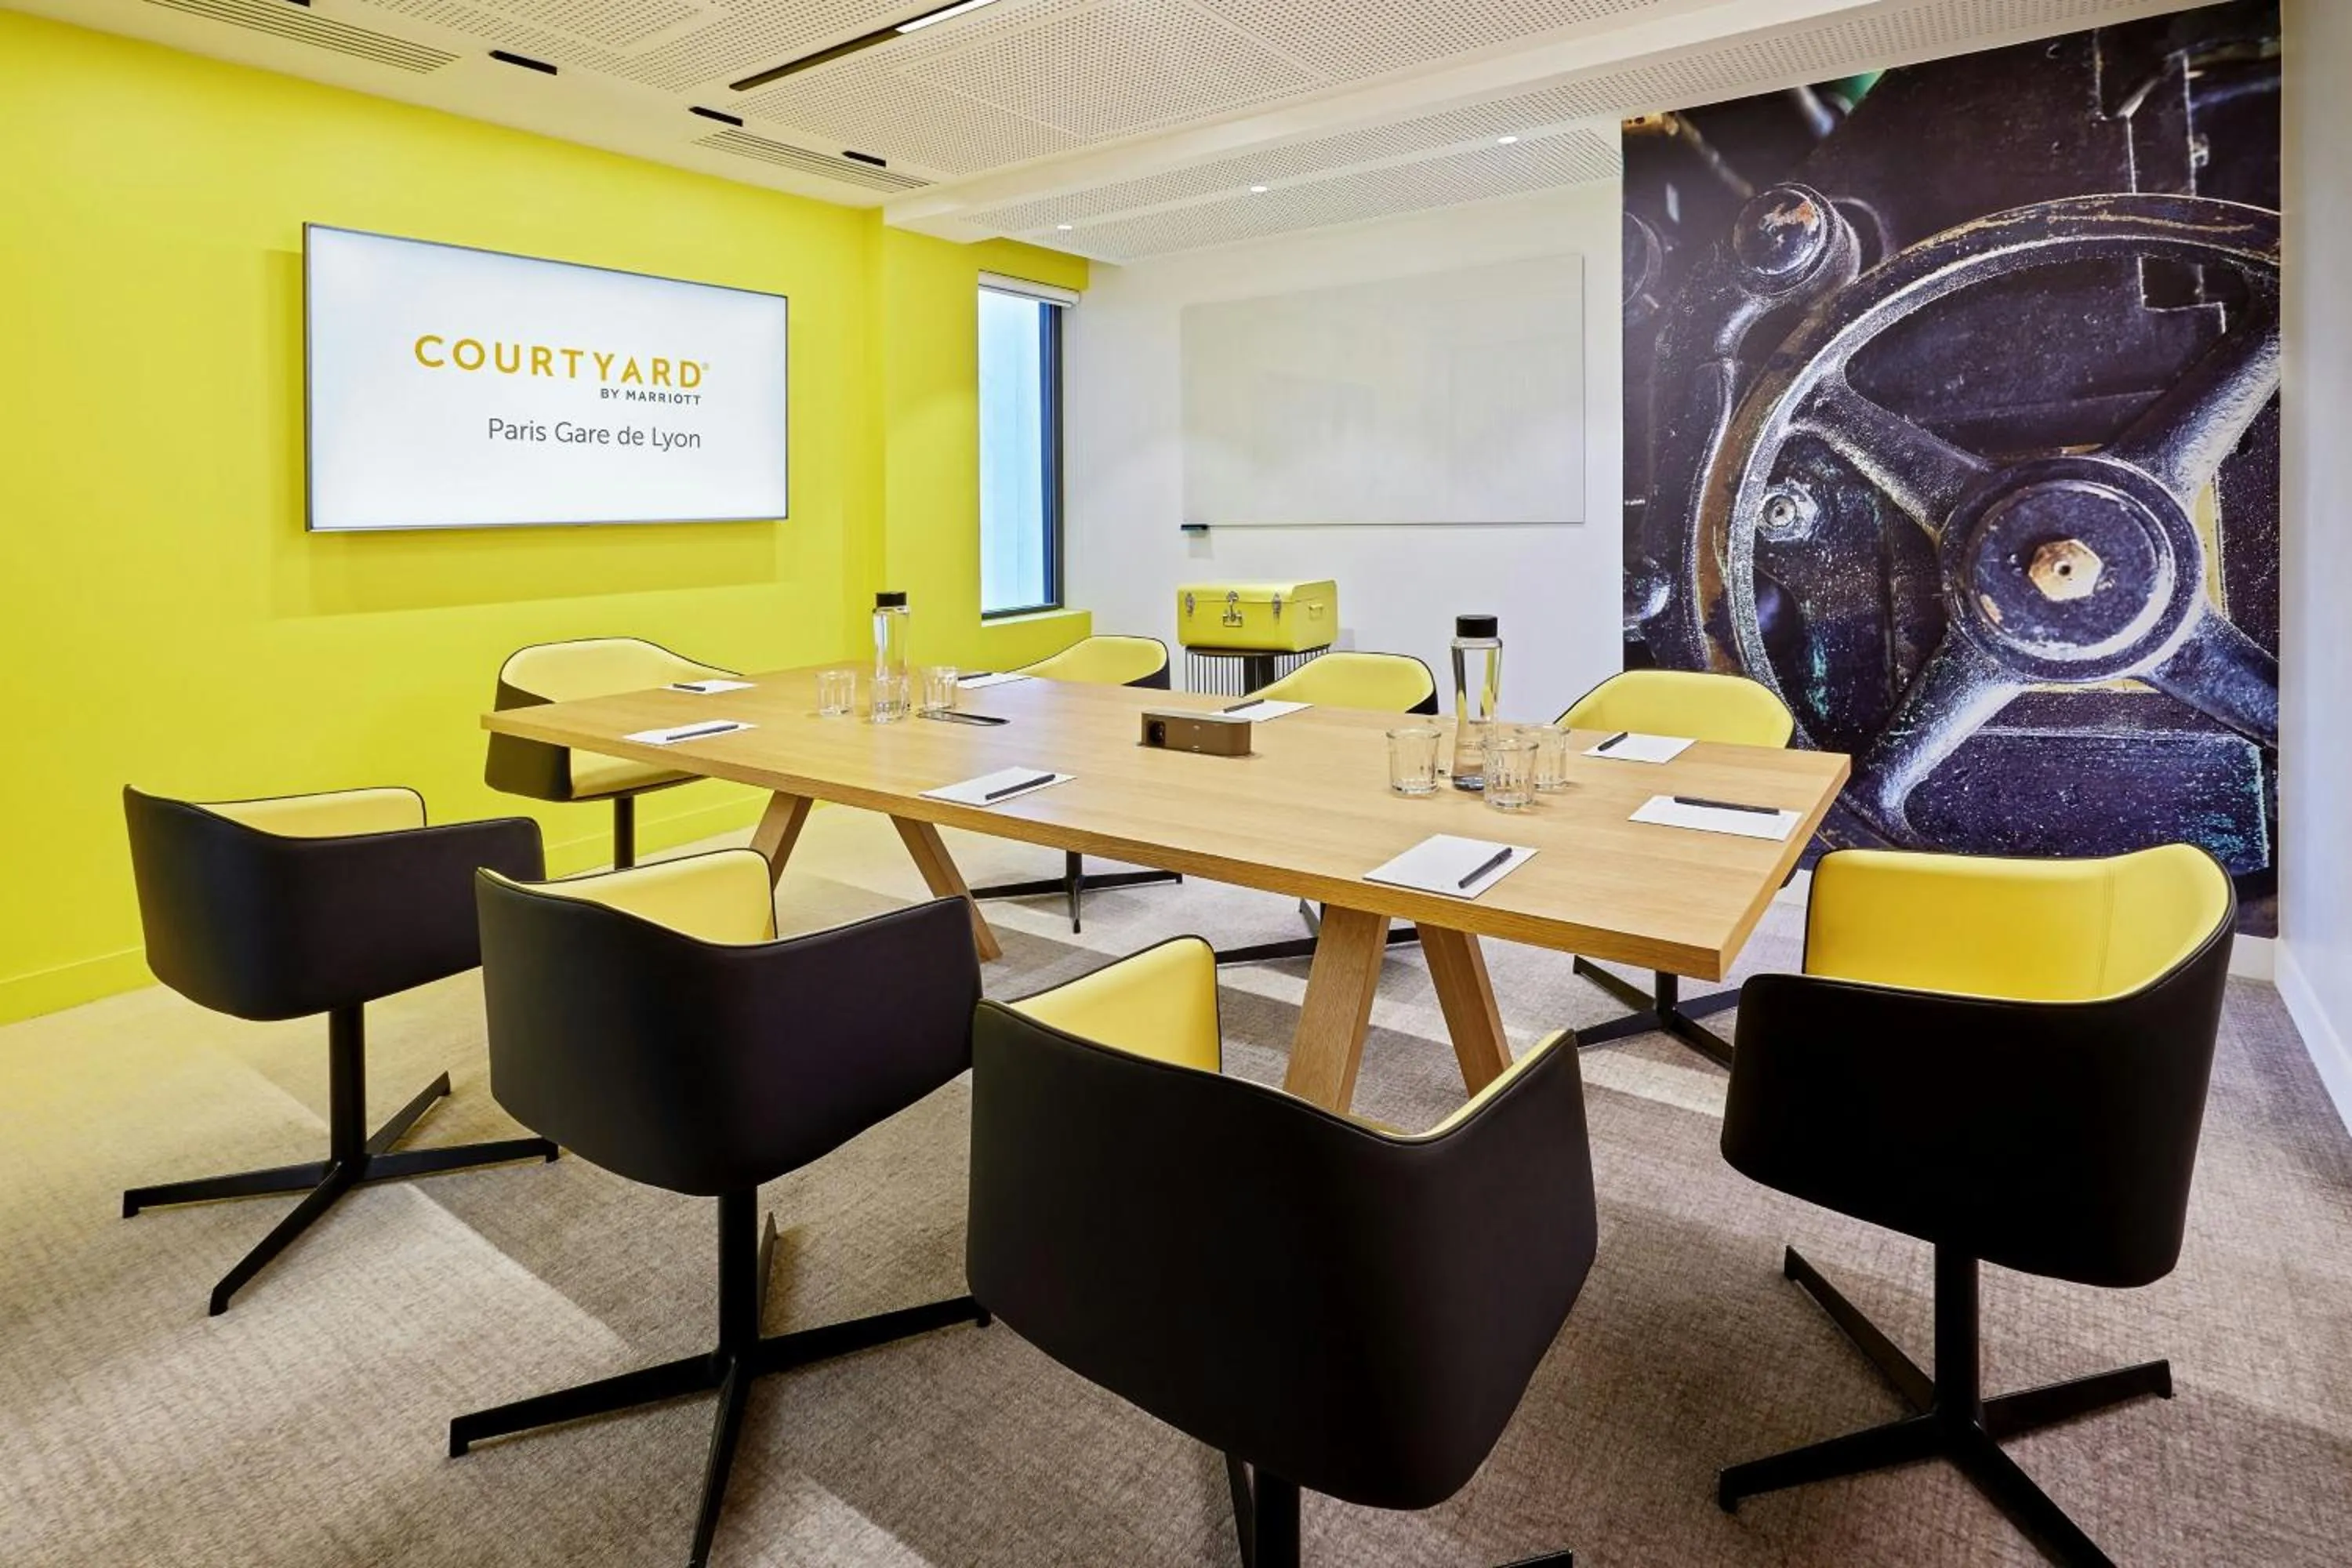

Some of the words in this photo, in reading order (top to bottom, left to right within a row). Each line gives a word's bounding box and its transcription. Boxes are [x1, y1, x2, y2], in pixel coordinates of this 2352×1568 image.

[414, 334, 702, 389] COURTYARD
[601, 388, 619, 399] BY
[626, 390, 701, 405] MARRIOTT
[488, 418, 546, 442] Paris
[555, 421, 610, 445] Gare
[618, 426, 644, 446] de
[652, 426, 701, 452] Lyon
